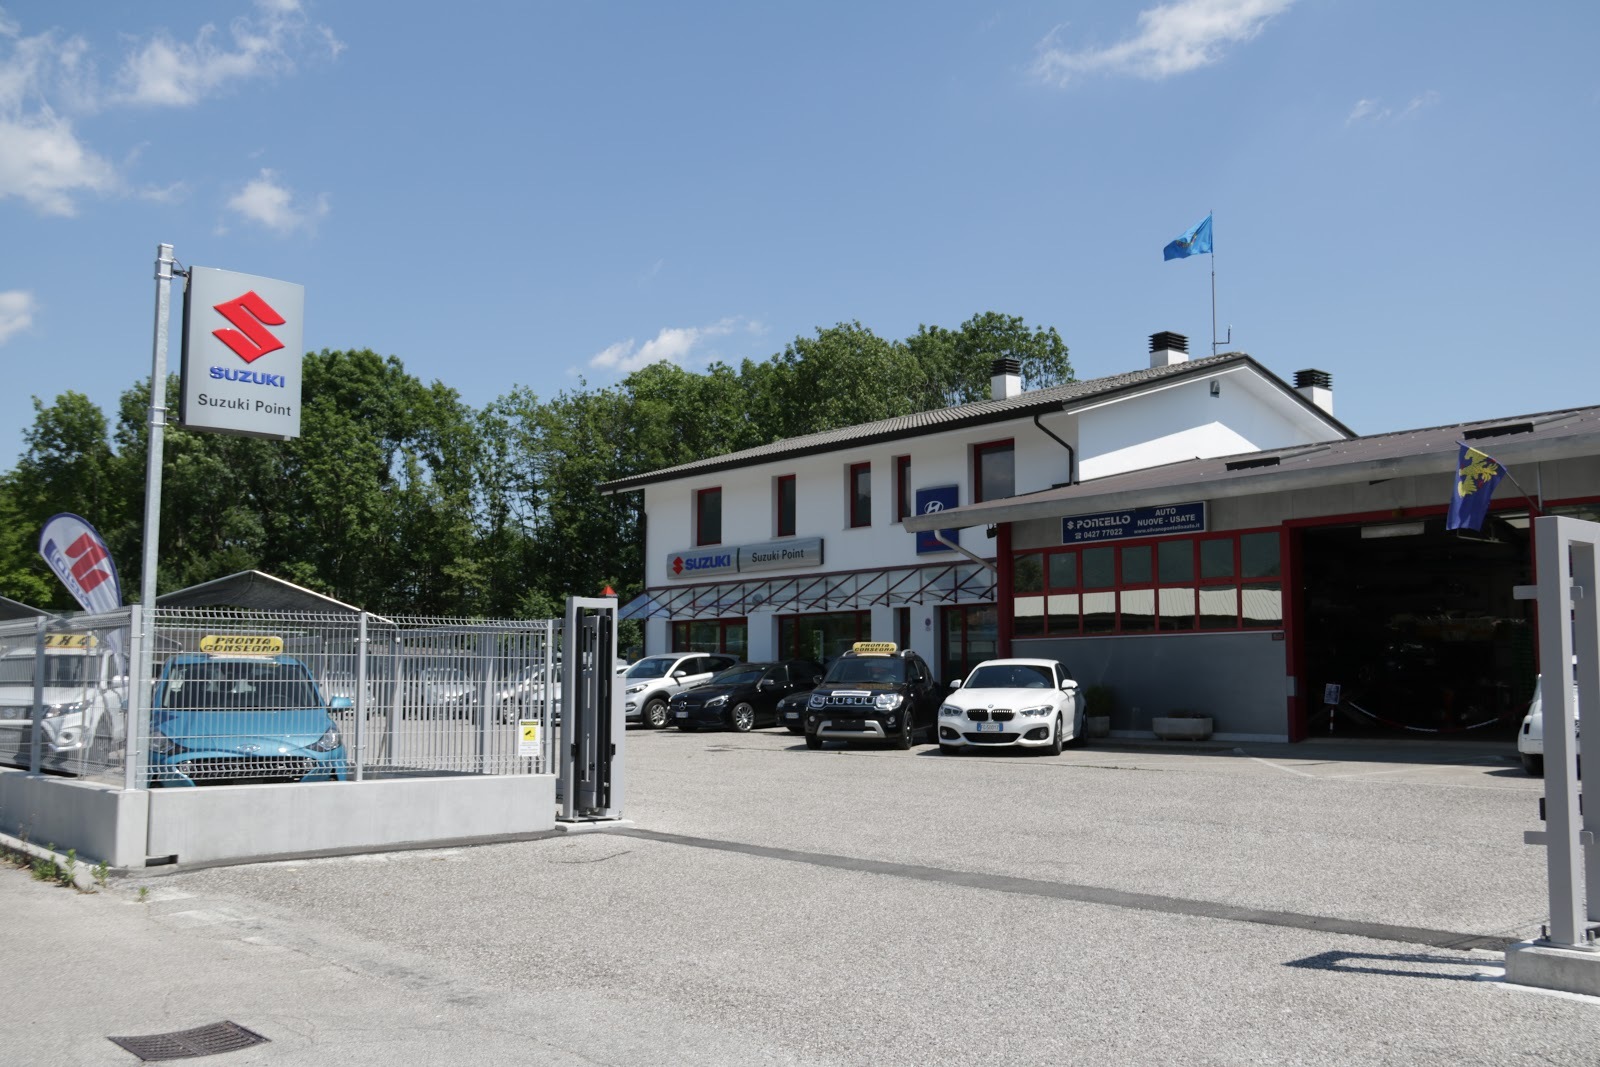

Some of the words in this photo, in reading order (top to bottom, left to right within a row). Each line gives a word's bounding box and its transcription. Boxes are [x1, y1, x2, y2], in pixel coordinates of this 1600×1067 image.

[209, 366, 285, 388] SUZUKI
[198, 393, 250, 411] Suzuki
[255, 400, 291, 416] Point
[1155, 507, 1176, 516] AUTO
[1076, 515, 1131, 530] PONTELLO
[1137, 518, 1164, 527] NUOVE
[1169, 514, 1195, 523] USATE
[1083, 530, 1100, 539] 0427
[1101, 528, 1123, 537] 77022
[685, 554, 731, 571] SUZUKI
[752, 551, 779, 563] Suzuki
[782, 549, 804, 559] Point
[215, 637, 271, 645] PRONTA
[203, 644, 280, 652] CONSEGNA
